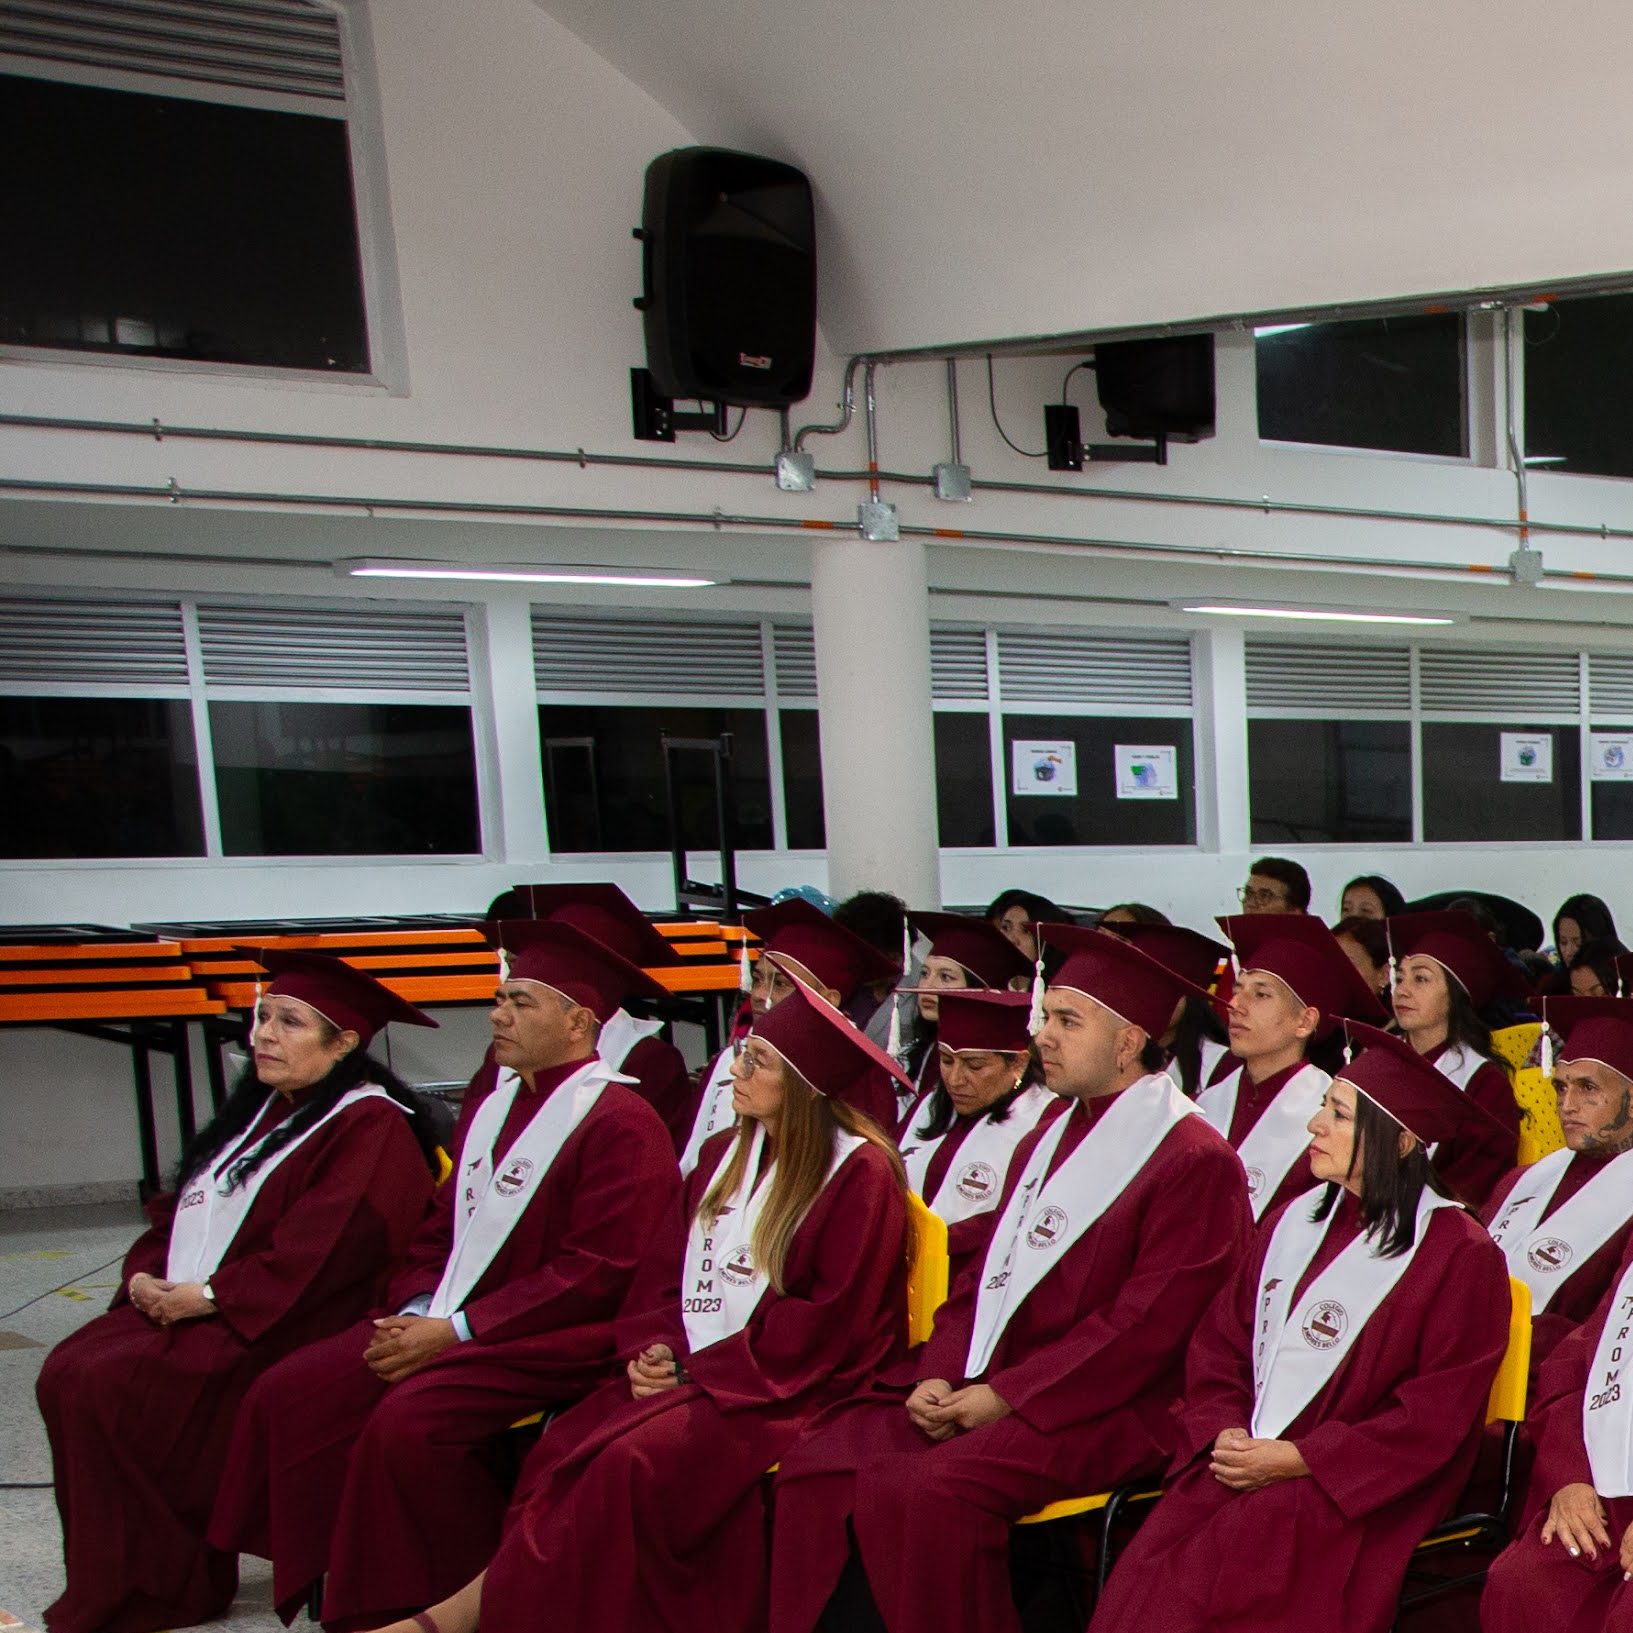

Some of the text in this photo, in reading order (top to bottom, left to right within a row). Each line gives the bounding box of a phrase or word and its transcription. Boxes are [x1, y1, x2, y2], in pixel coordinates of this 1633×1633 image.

[986, 1272, 1011, 1289] 202
[683, 1298, 722, 1313] 2023
[1589, 1384, 1620, 1411] 2023
